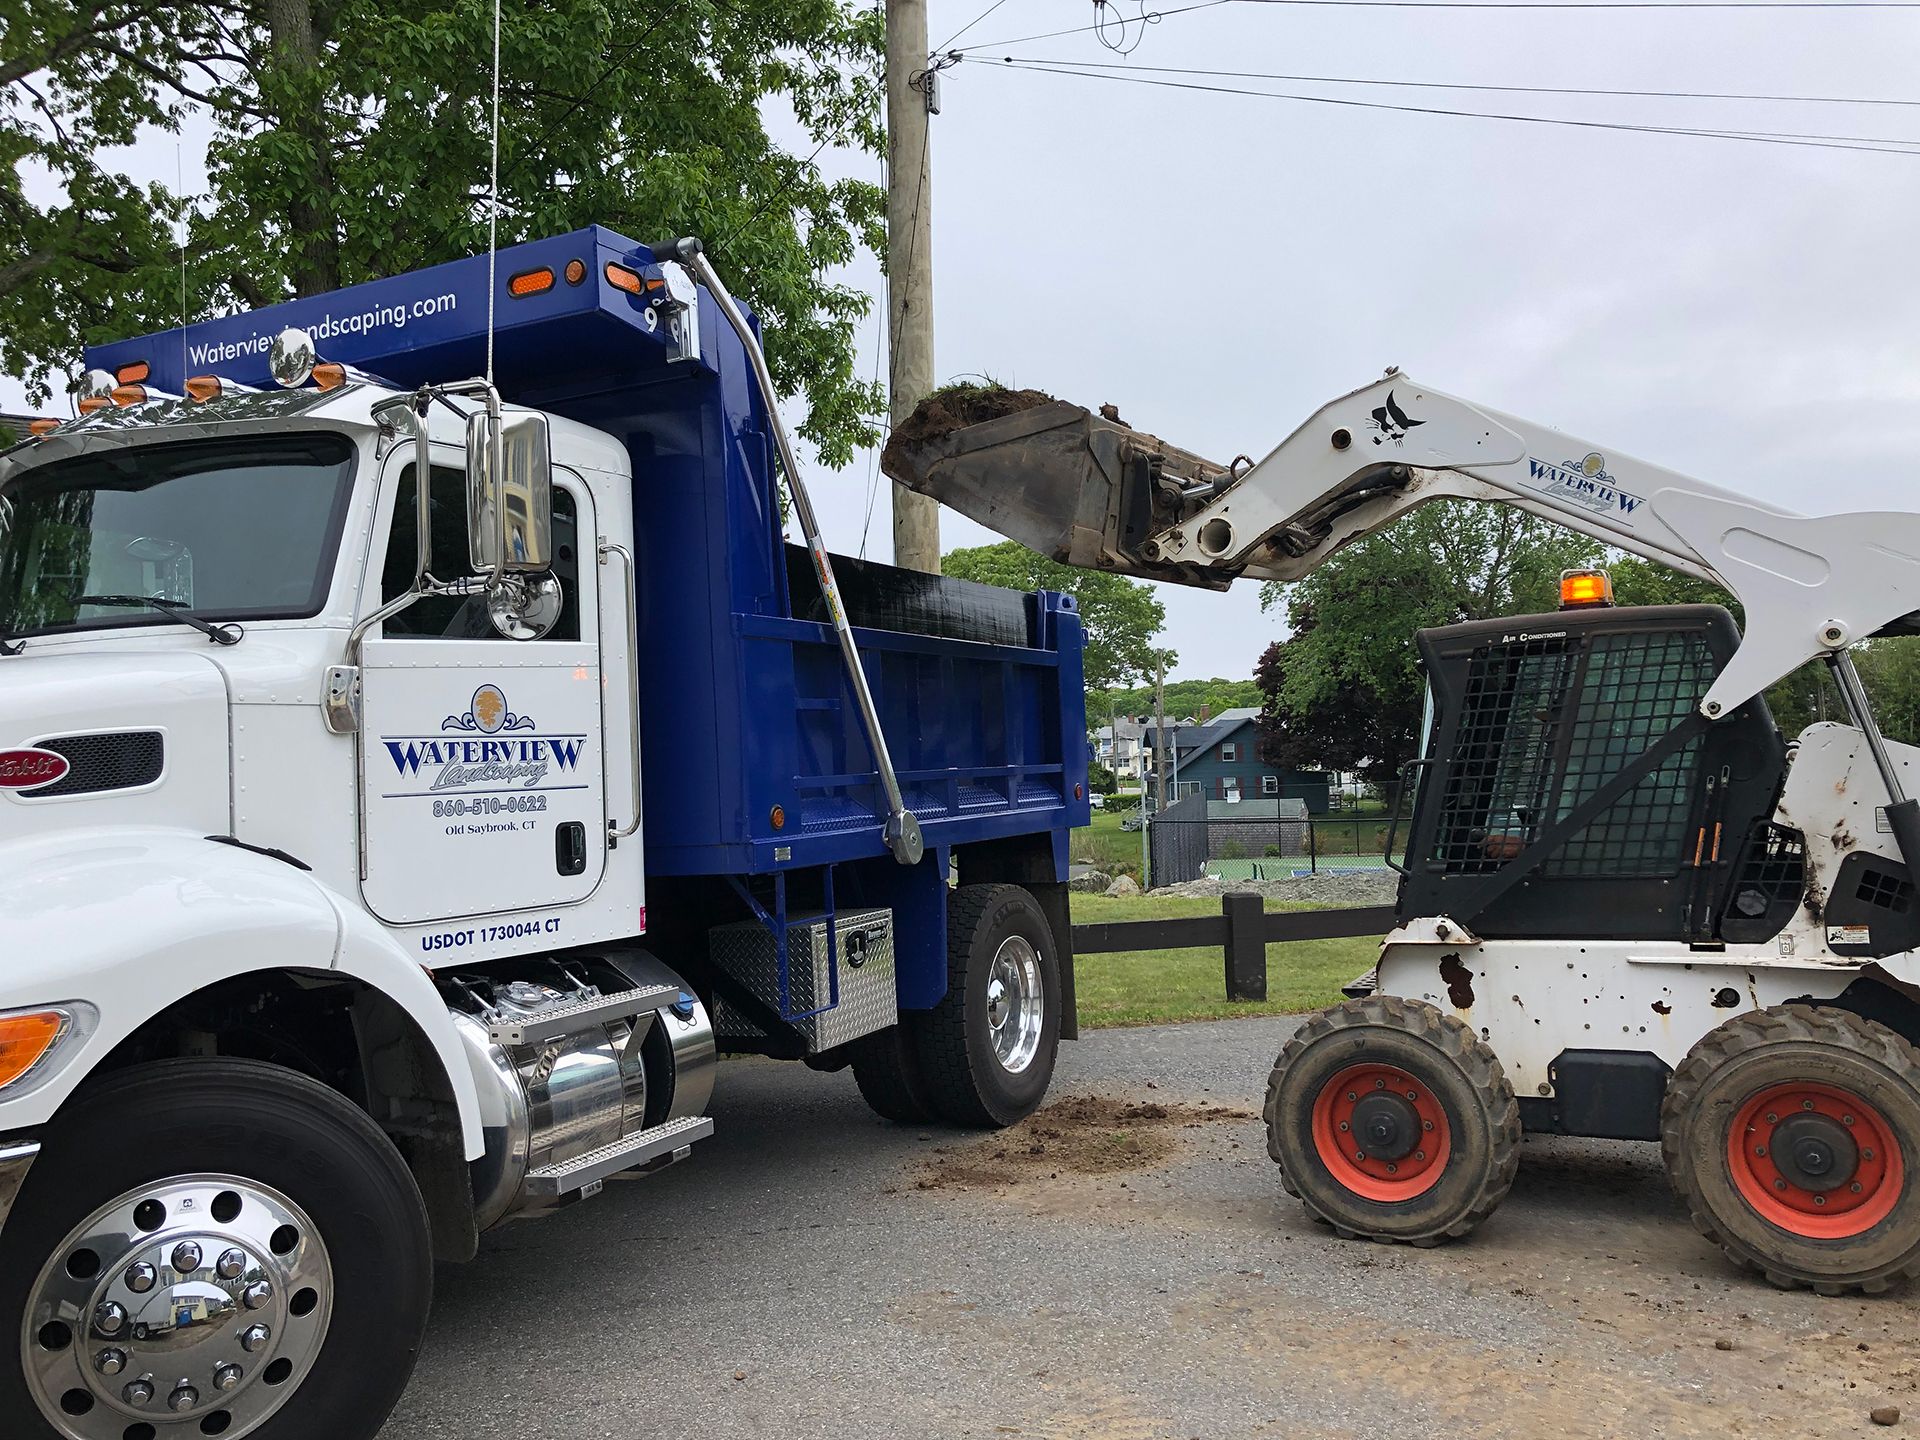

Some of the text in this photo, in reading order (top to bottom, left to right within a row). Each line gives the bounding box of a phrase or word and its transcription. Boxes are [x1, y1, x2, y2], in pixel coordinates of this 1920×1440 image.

[189, 292, 457, 367] Waterviendscaping.com
[1529, 459, 1644, 514] WATERVIEW
[0, 757, 59, 777] terbilt
[383, 739, 586, 779] WATERVIEW
[430, 755, 548, 790] Landscaping
[432, 795, 547, 818] 860-510-0622
[445, 820, 536, 836] Old Saybrook, CT
[422, 918, 560, 951] USDOT 1730044 CT
